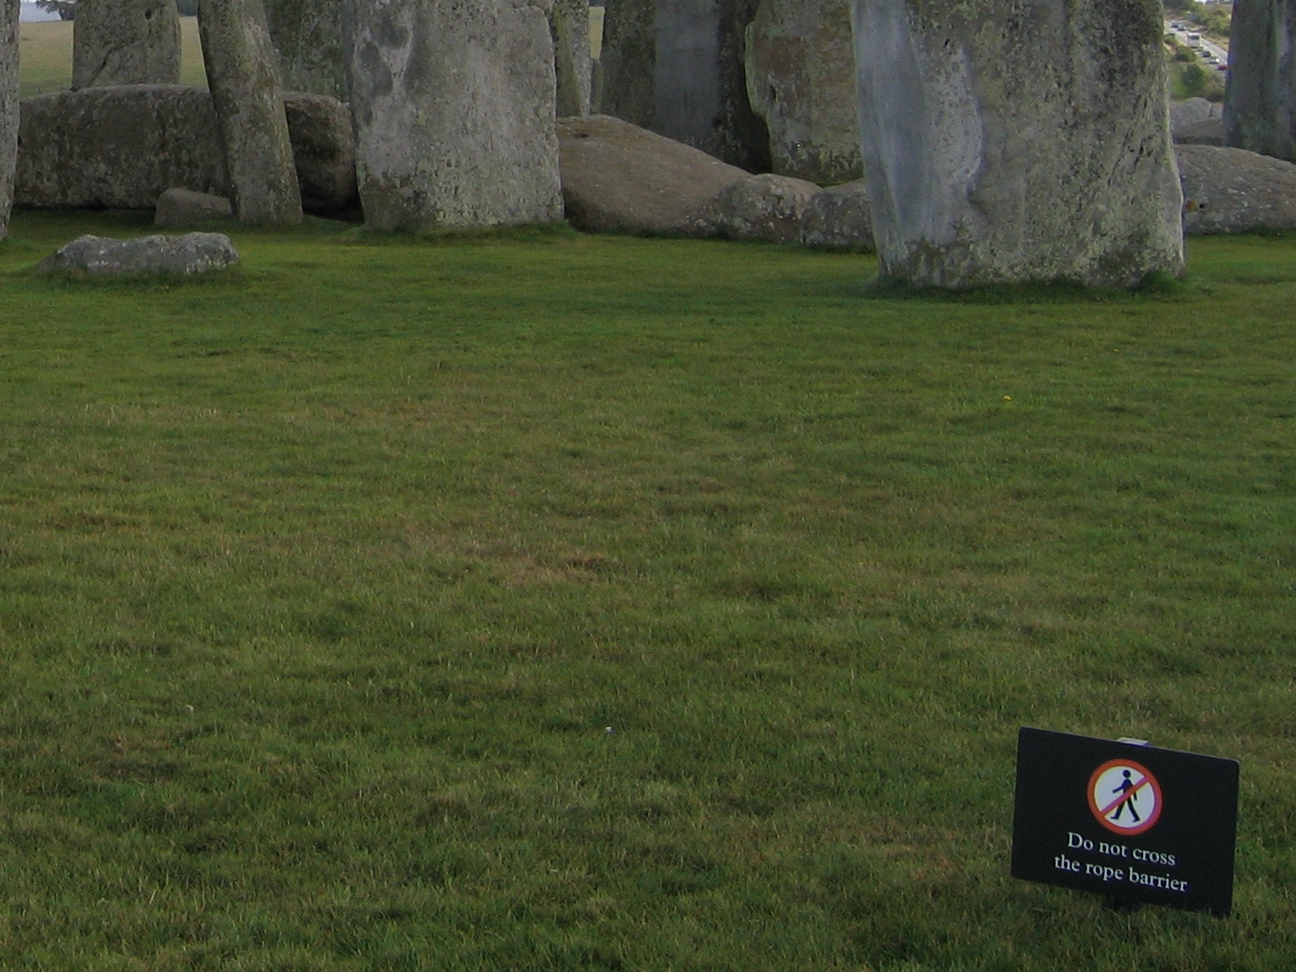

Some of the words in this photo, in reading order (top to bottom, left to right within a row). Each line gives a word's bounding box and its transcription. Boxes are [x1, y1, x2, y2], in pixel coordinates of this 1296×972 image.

[1067, 831, 1093, 850] Do
[1099, 842, 1128, 857] not
[1132, 848, 1176, 866] cross
[1054, 854, 1080, 871] the
[1085, 863, 1124, 881] rope
[1129, 867, 1188, 892] barrier
